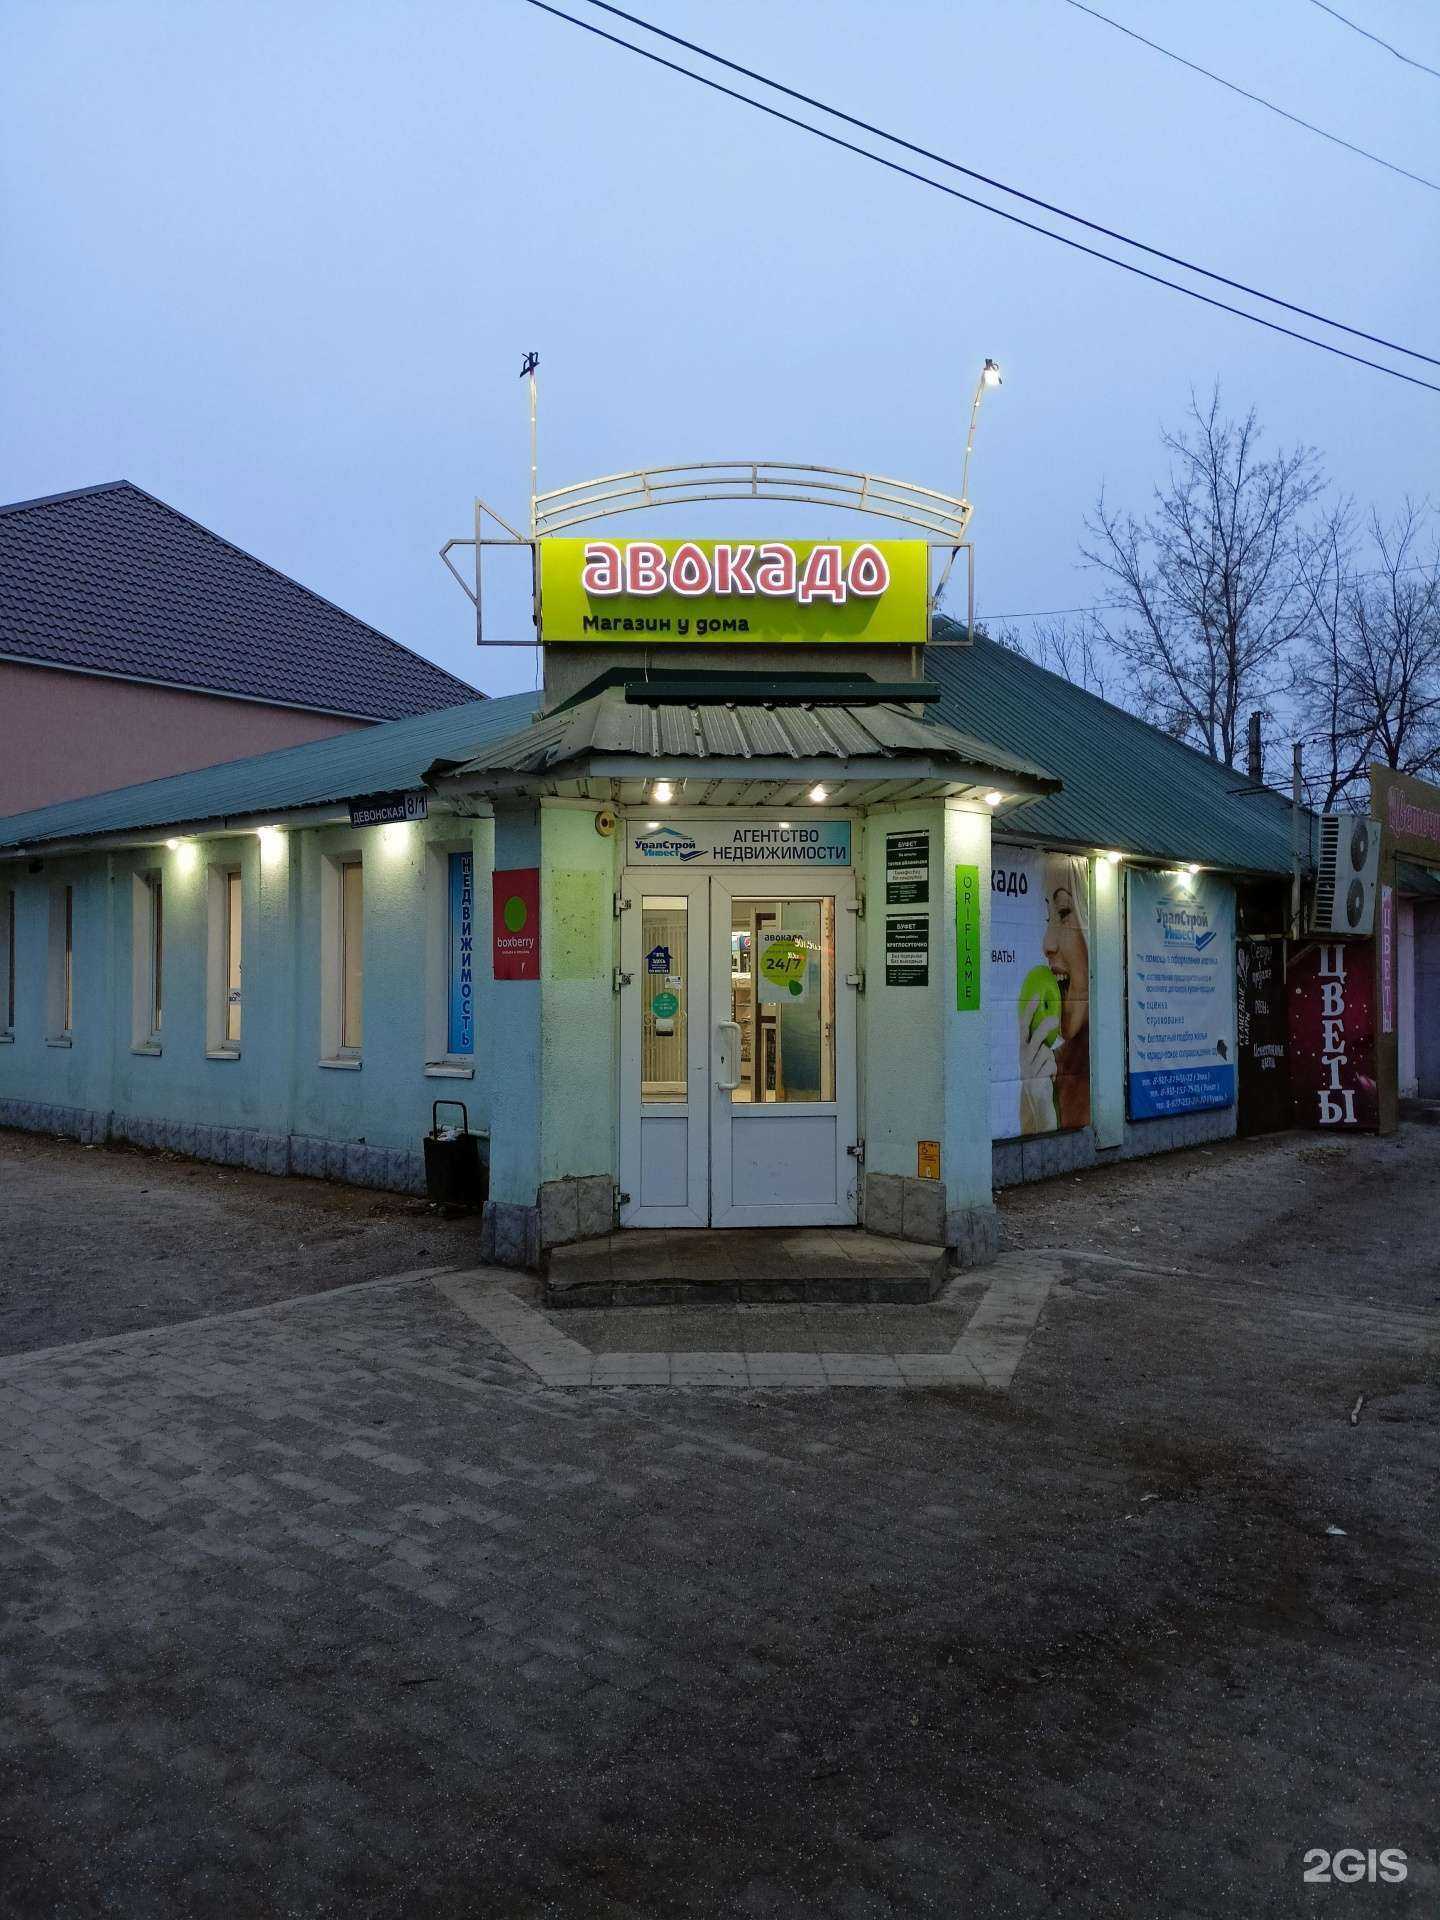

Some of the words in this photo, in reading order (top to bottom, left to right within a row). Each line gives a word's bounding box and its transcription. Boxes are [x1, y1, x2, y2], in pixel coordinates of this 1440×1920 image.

[582, 541, 891, 603] авокадо
[583, 616, 671, 632] Магазин
[677, 618, 689, 634] у
[696, 616, 749, 635] дома
[353, 806, 405, 825] ДЕВОНСКАЯ
[407, 796, 425, 815] 8/1
[634, 840, 696, 850] УралСтрой
[733, 829, 819, 843] АГЕНТСТВО
[713, 846, 846, 861] НЕДВИЖИМОСТИ
[497, 936, 534, 949] boxberry
[963, 876, 973, 998] ORIFLAME
[461, 856, 473, 1048] НЕДВИЖИМОСТЬ
[766, 958, 801, 973] 24/7
[1317, 944, 1357, 1124] ЦВЕТЫ
